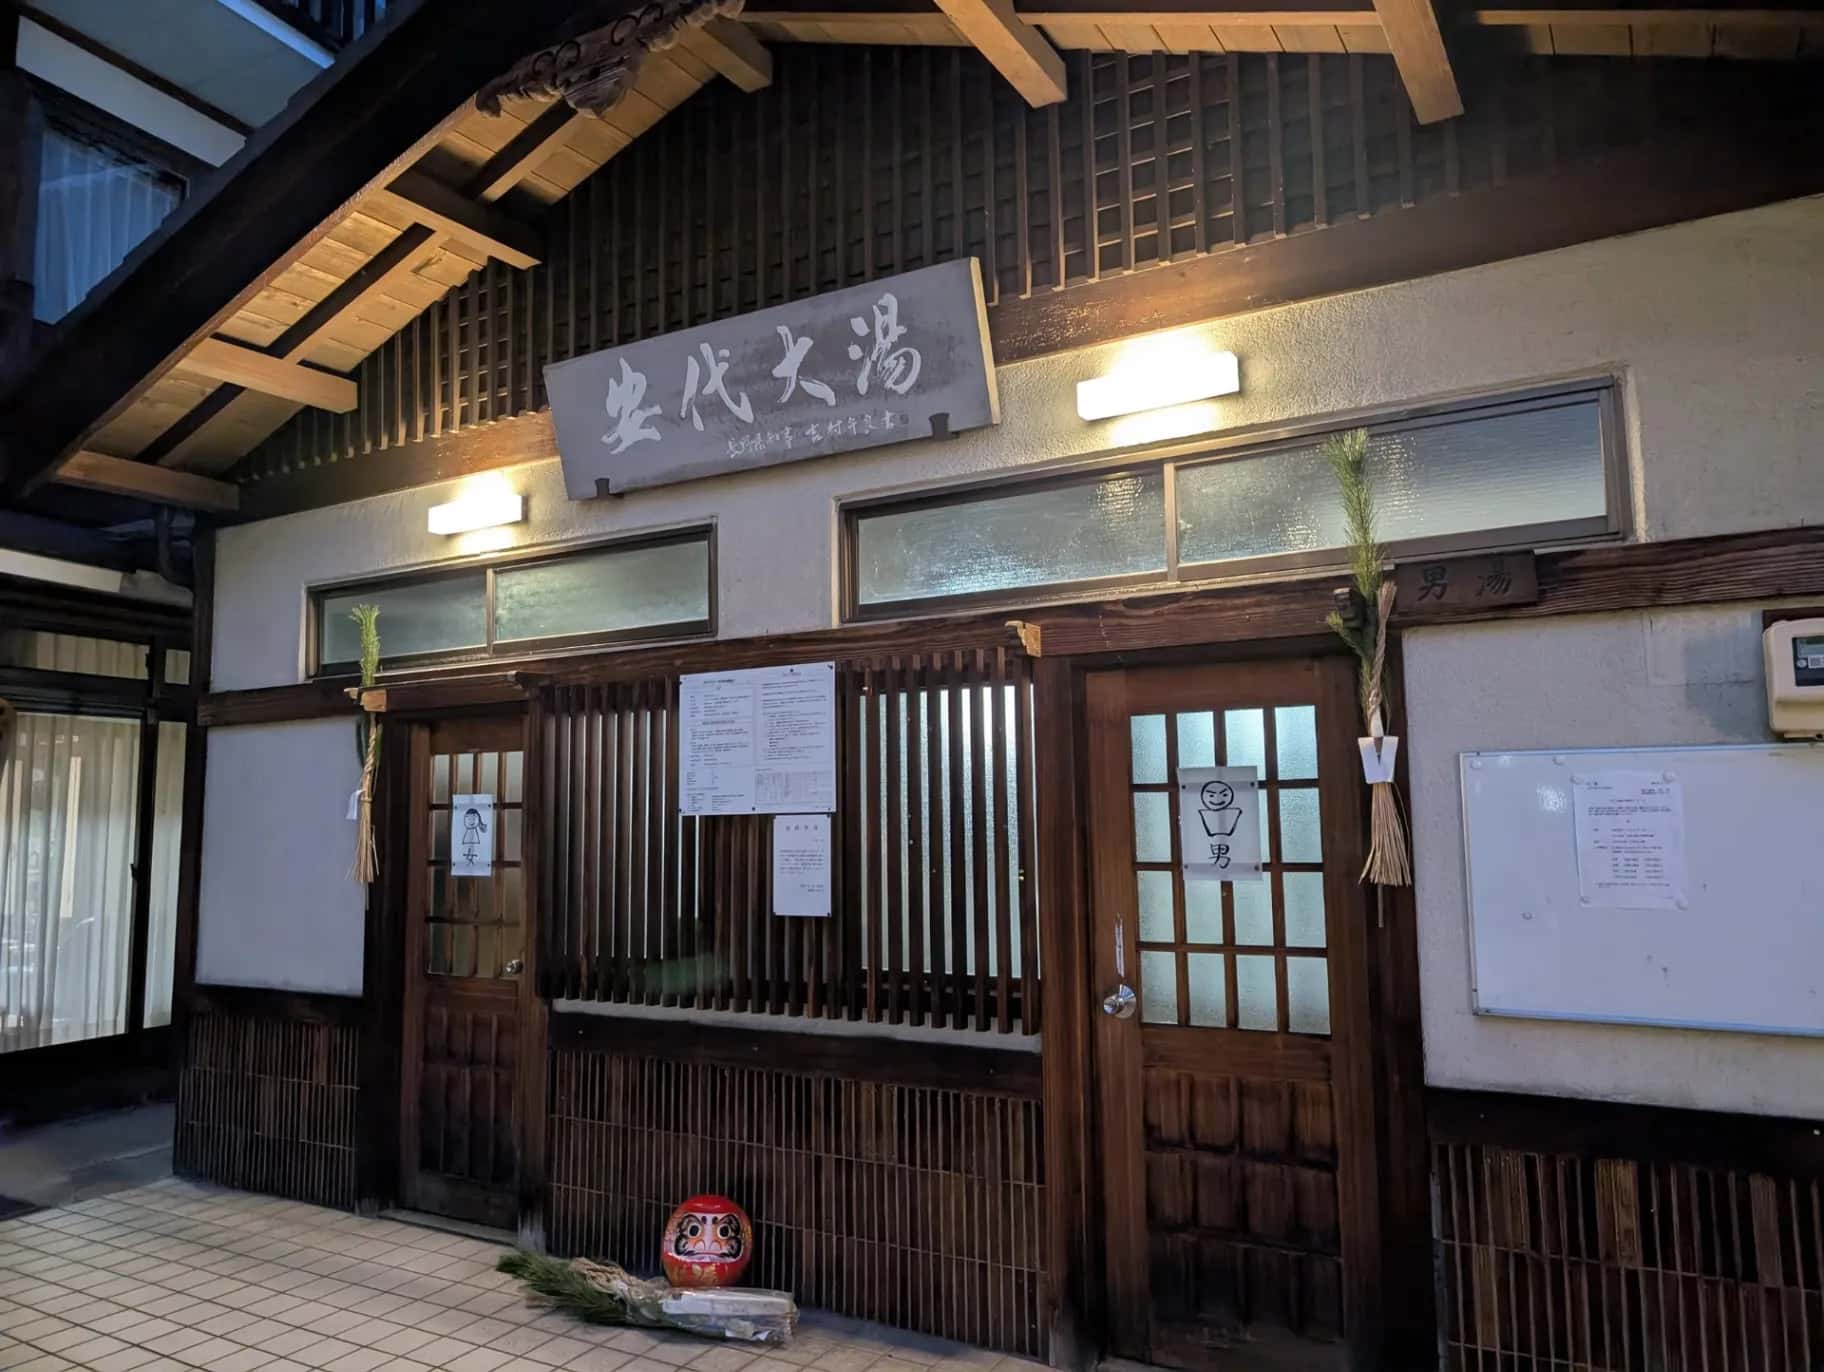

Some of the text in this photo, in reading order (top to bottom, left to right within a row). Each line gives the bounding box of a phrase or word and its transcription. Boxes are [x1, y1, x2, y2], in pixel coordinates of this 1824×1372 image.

[601, 293, 922, 455] 安代大湯
[1417, 560, 1513, 601] 男湯
[463, 848, 478, 866] 女
[1208, 843, 1231, 869] 男
